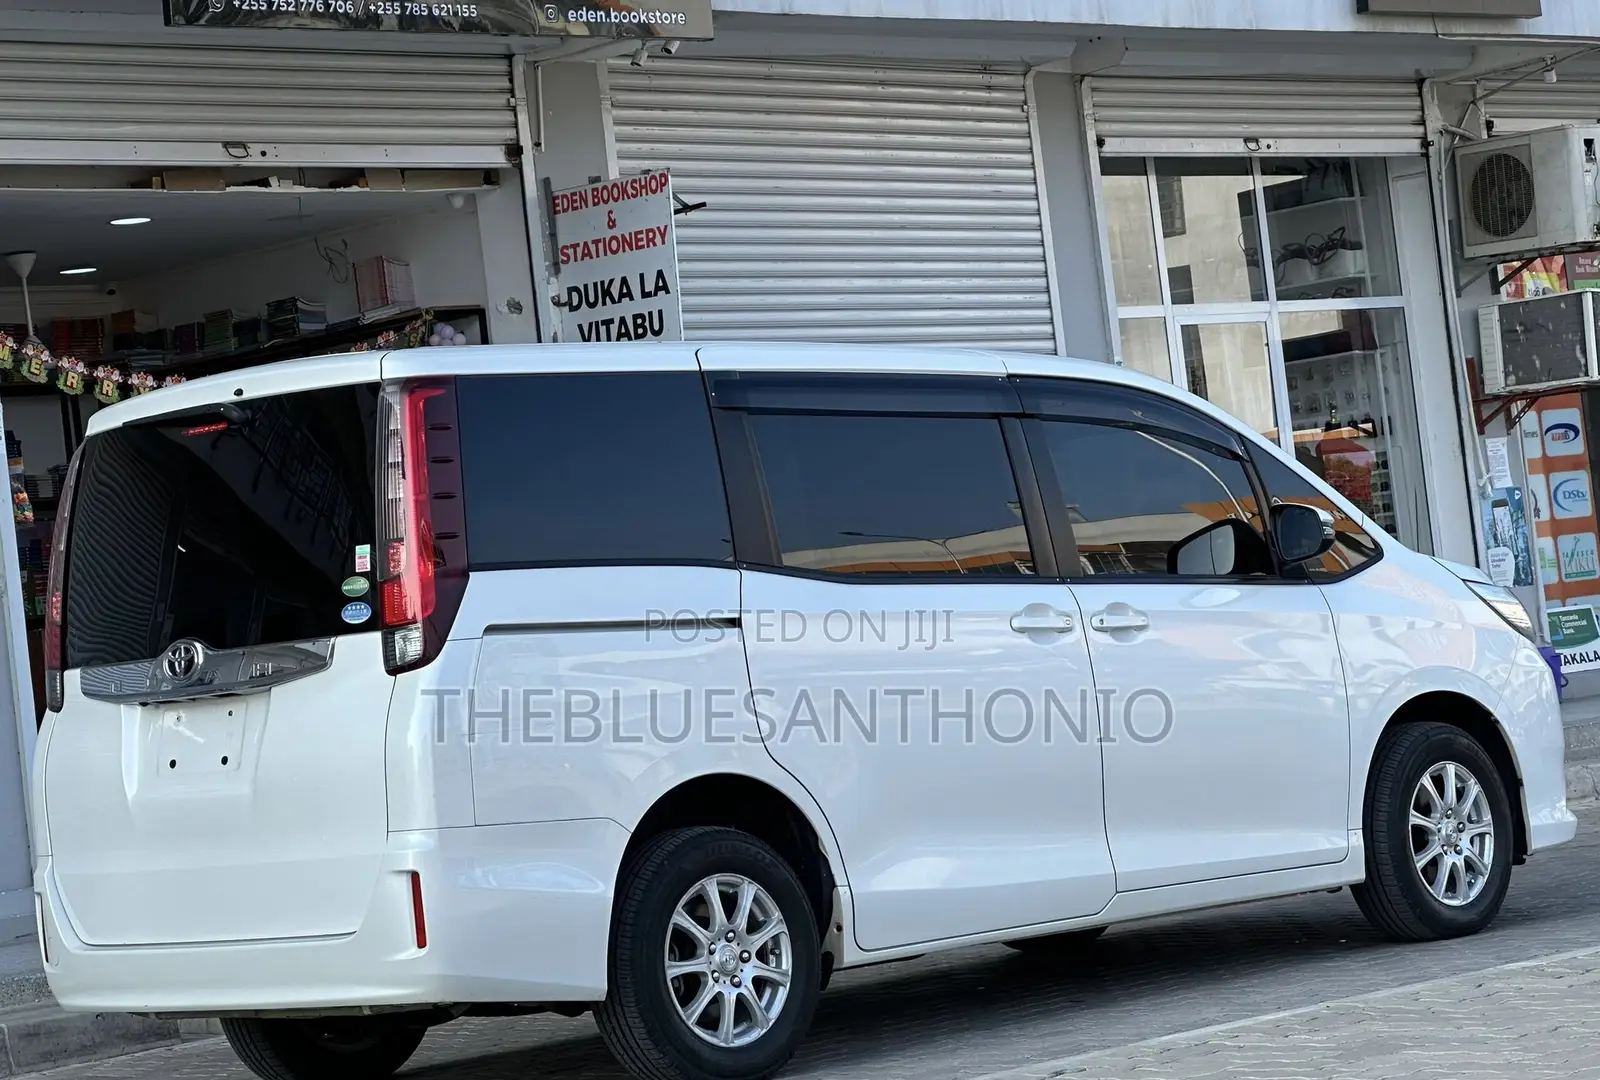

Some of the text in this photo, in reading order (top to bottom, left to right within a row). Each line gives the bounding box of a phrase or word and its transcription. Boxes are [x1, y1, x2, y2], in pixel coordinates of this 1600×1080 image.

[233, 0, 267, 10] +255
[272, 0, 296, 11] 752
[301, 0, 324, 12] 776
[328, 0, 354, 13] 706
[369, 2, 401, 15] +255
[404, 3, 428, 16] 785
[432, 4, 453, 16] 621
[456, 4, 478, 17] 155
[567, 6, 686, 25] eden.bookstore
[552, 172, 668, 216] EDEN BOOKSHOP
[607, 209, 617, 230] &
[560, 225, 668, 265] STATIONERY
[567, 269, 671, 313] DUKA LA
[577, 309, 664, 342] VITABU
